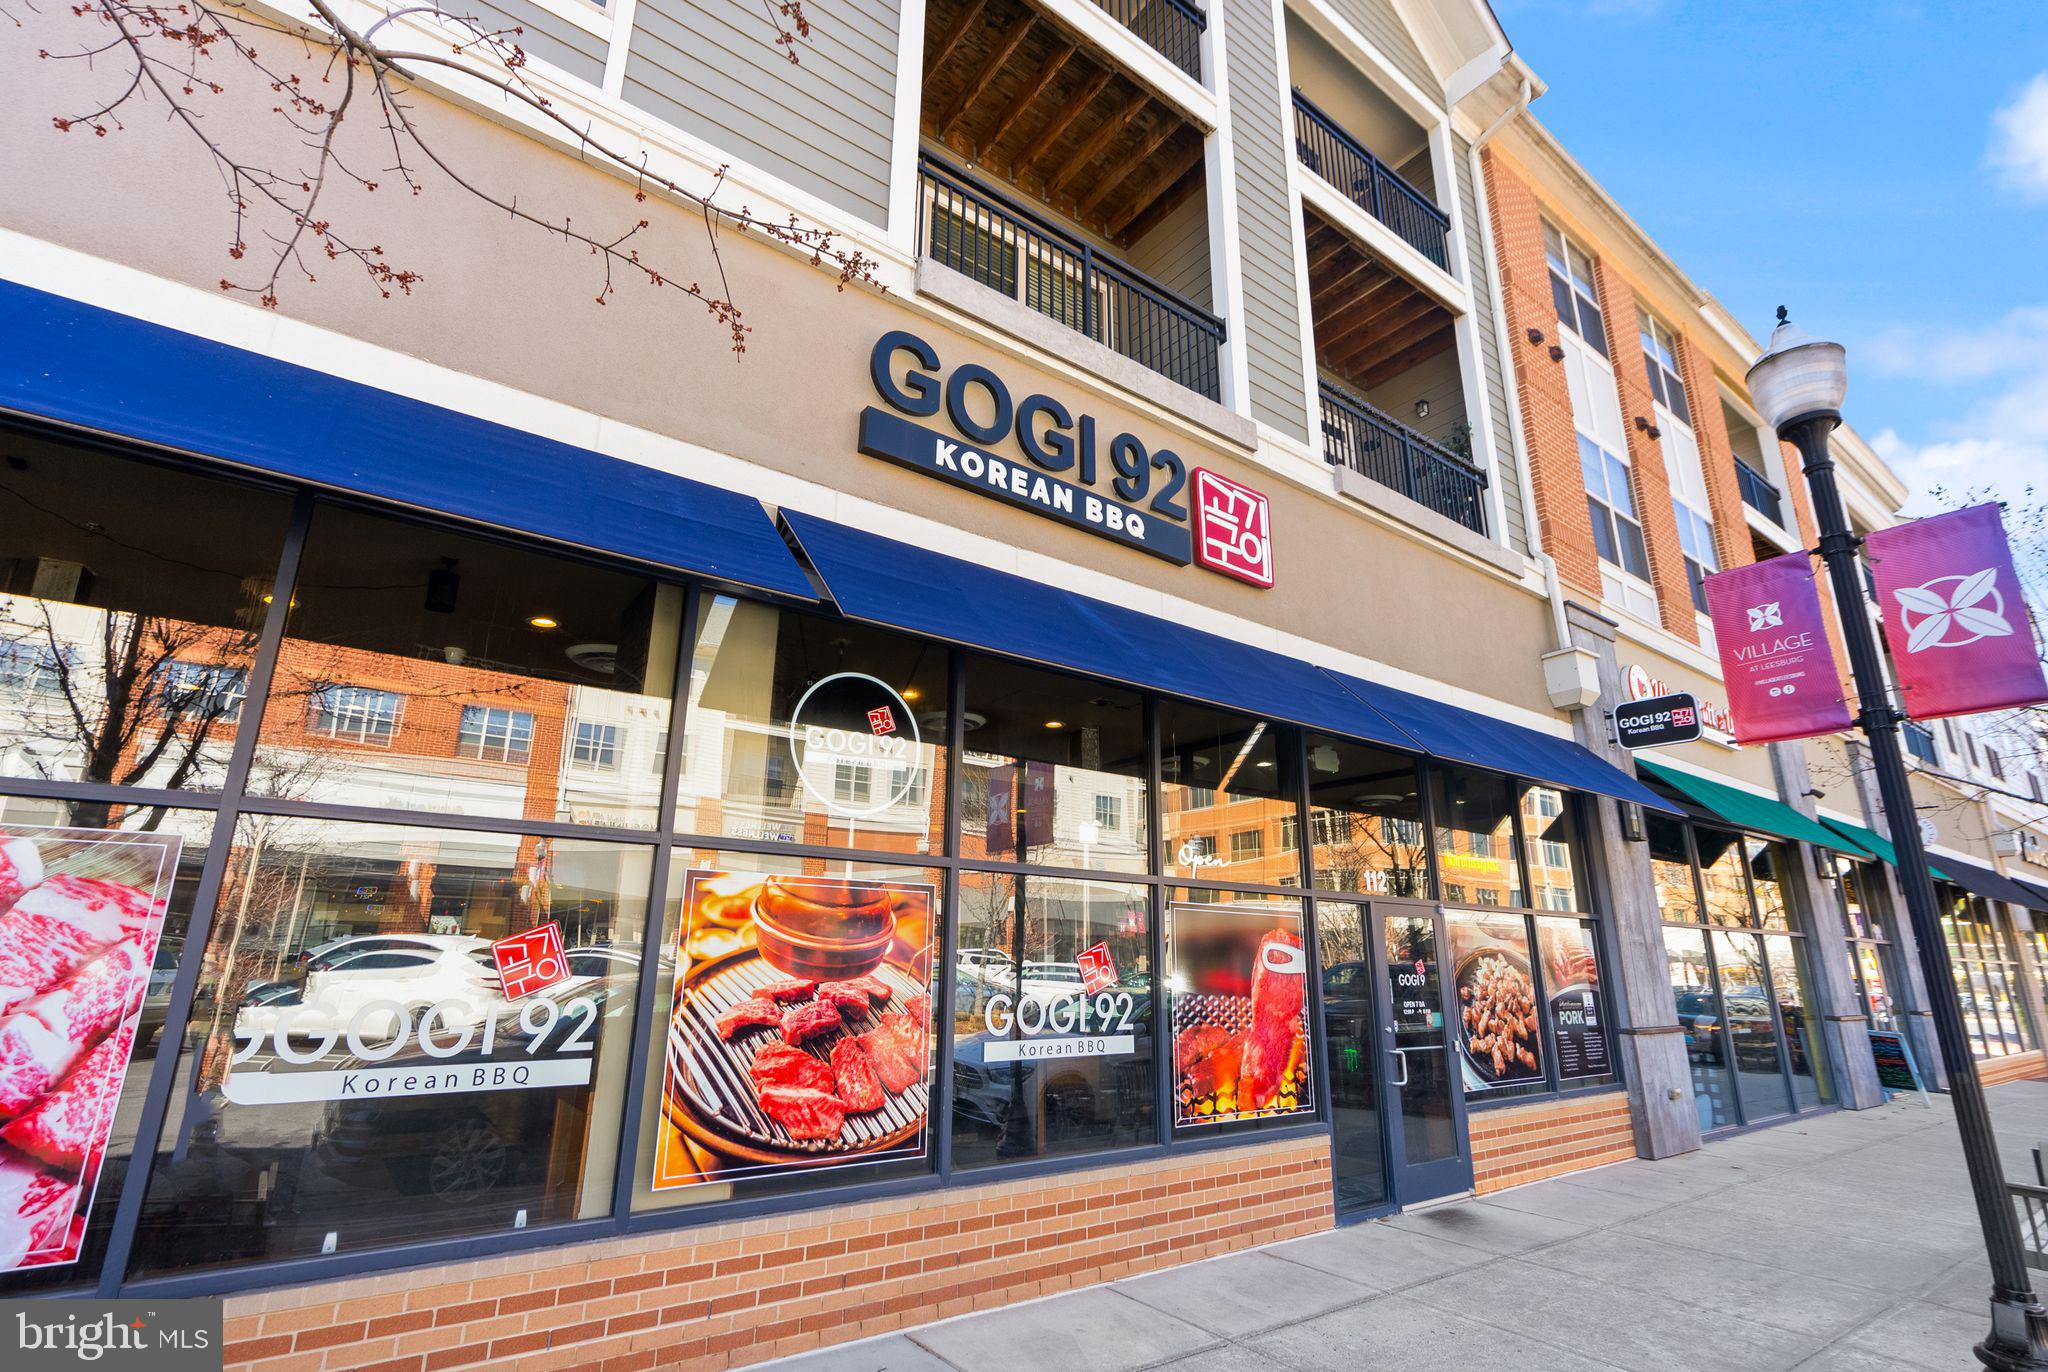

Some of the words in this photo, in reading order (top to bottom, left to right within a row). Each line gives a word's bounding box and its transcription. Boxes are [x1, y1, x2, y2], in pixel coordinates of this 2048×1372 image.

[870, 330, 1097, 486] GOGI
[1110, 432, 1188, 522] 92
[935, 439, 1073, 513] KOREAN
[1085, 495, 1145, 540] BBQ
[1733, 632, 1814, 660] VILLAGE
[1761, 656, 1804, 670] LEESBURG
[1619, 714, 1654, 728] GOGI
[1655, 711, 1671, 723] 92
[1627, 726, 1650, 735] Korean
[1650, 723, 1664, 731] BBQ
[805, 726, 874, 754] GOGI
[880, 735, 906, 758] 92
[1178, 844, 1232, 880] Open
[1364, 869, 1387, 892] 112
[1398, 974, 1420, 986] GOGI
[520, 999, 597, 1056] 92
[985, 993, 1087, 1036] GOGI
[1095, 992, 1133, 1032] 92
[1559, 1010, 1584, 1025] PORK
[1019, 1043, 1072, 1057] Korean
[1078, 1040, 1105, 1053] BBQ
[341, 1073, 458, 1094] Korean
[472, 1065, 530, 1086] BBQ
